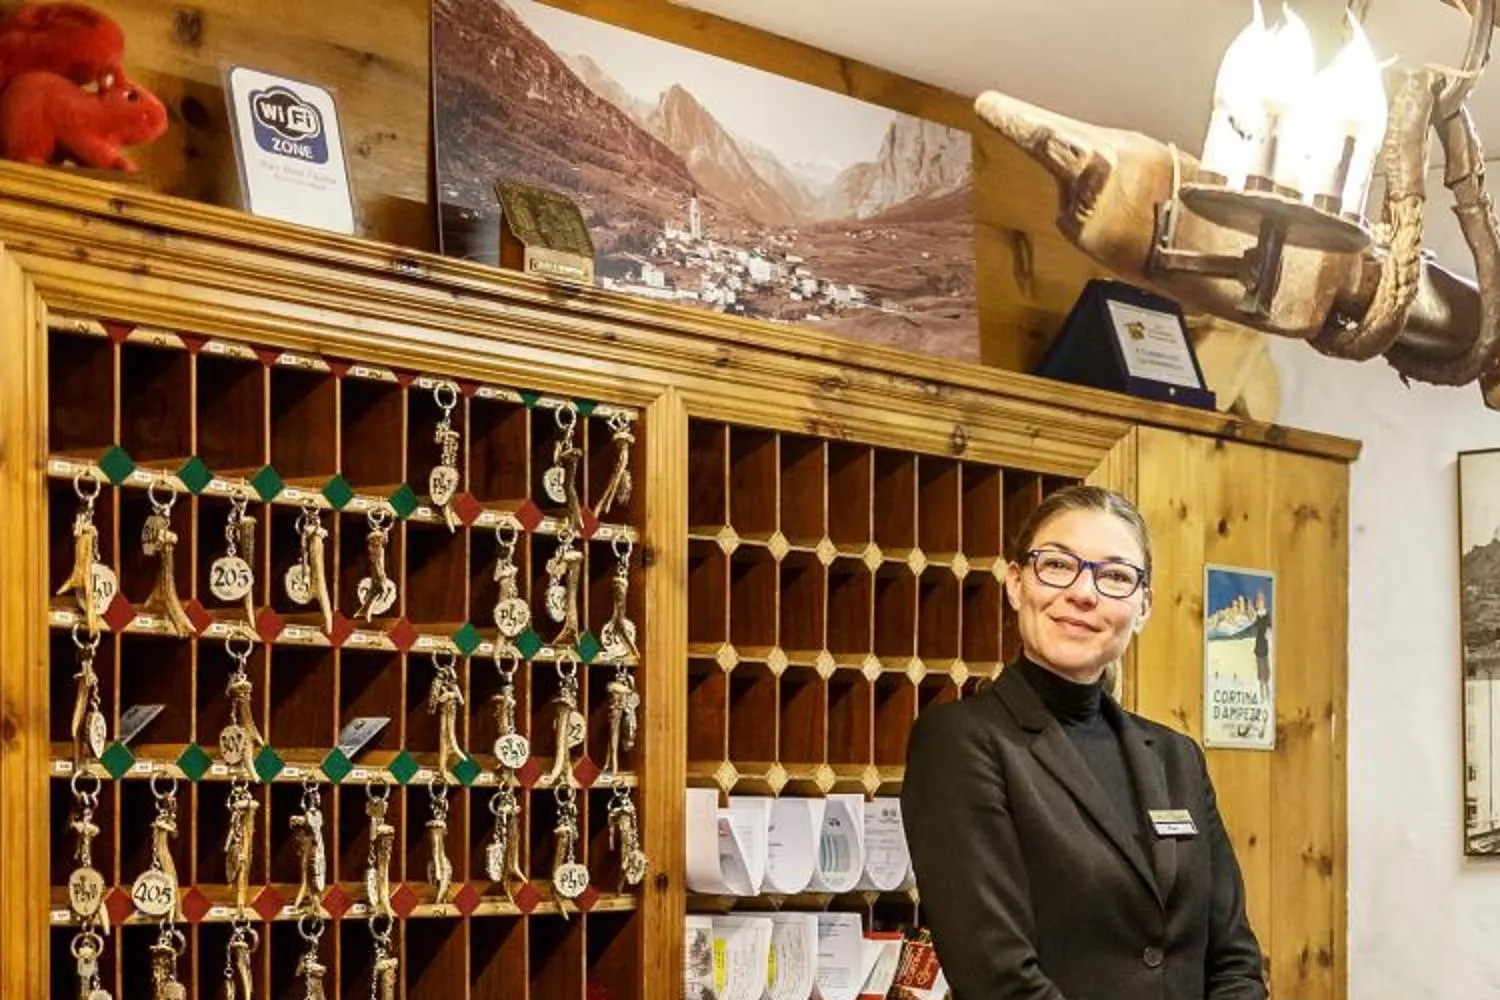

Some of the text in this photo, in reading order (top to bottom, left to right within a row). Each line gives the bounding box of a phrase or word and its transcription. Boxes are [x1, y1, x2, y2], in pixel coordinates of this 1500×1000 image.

[271, 137, 314, 159] ZONE
[214, 566, 249, 589] 205
[134, 882, 172, 903] 405
